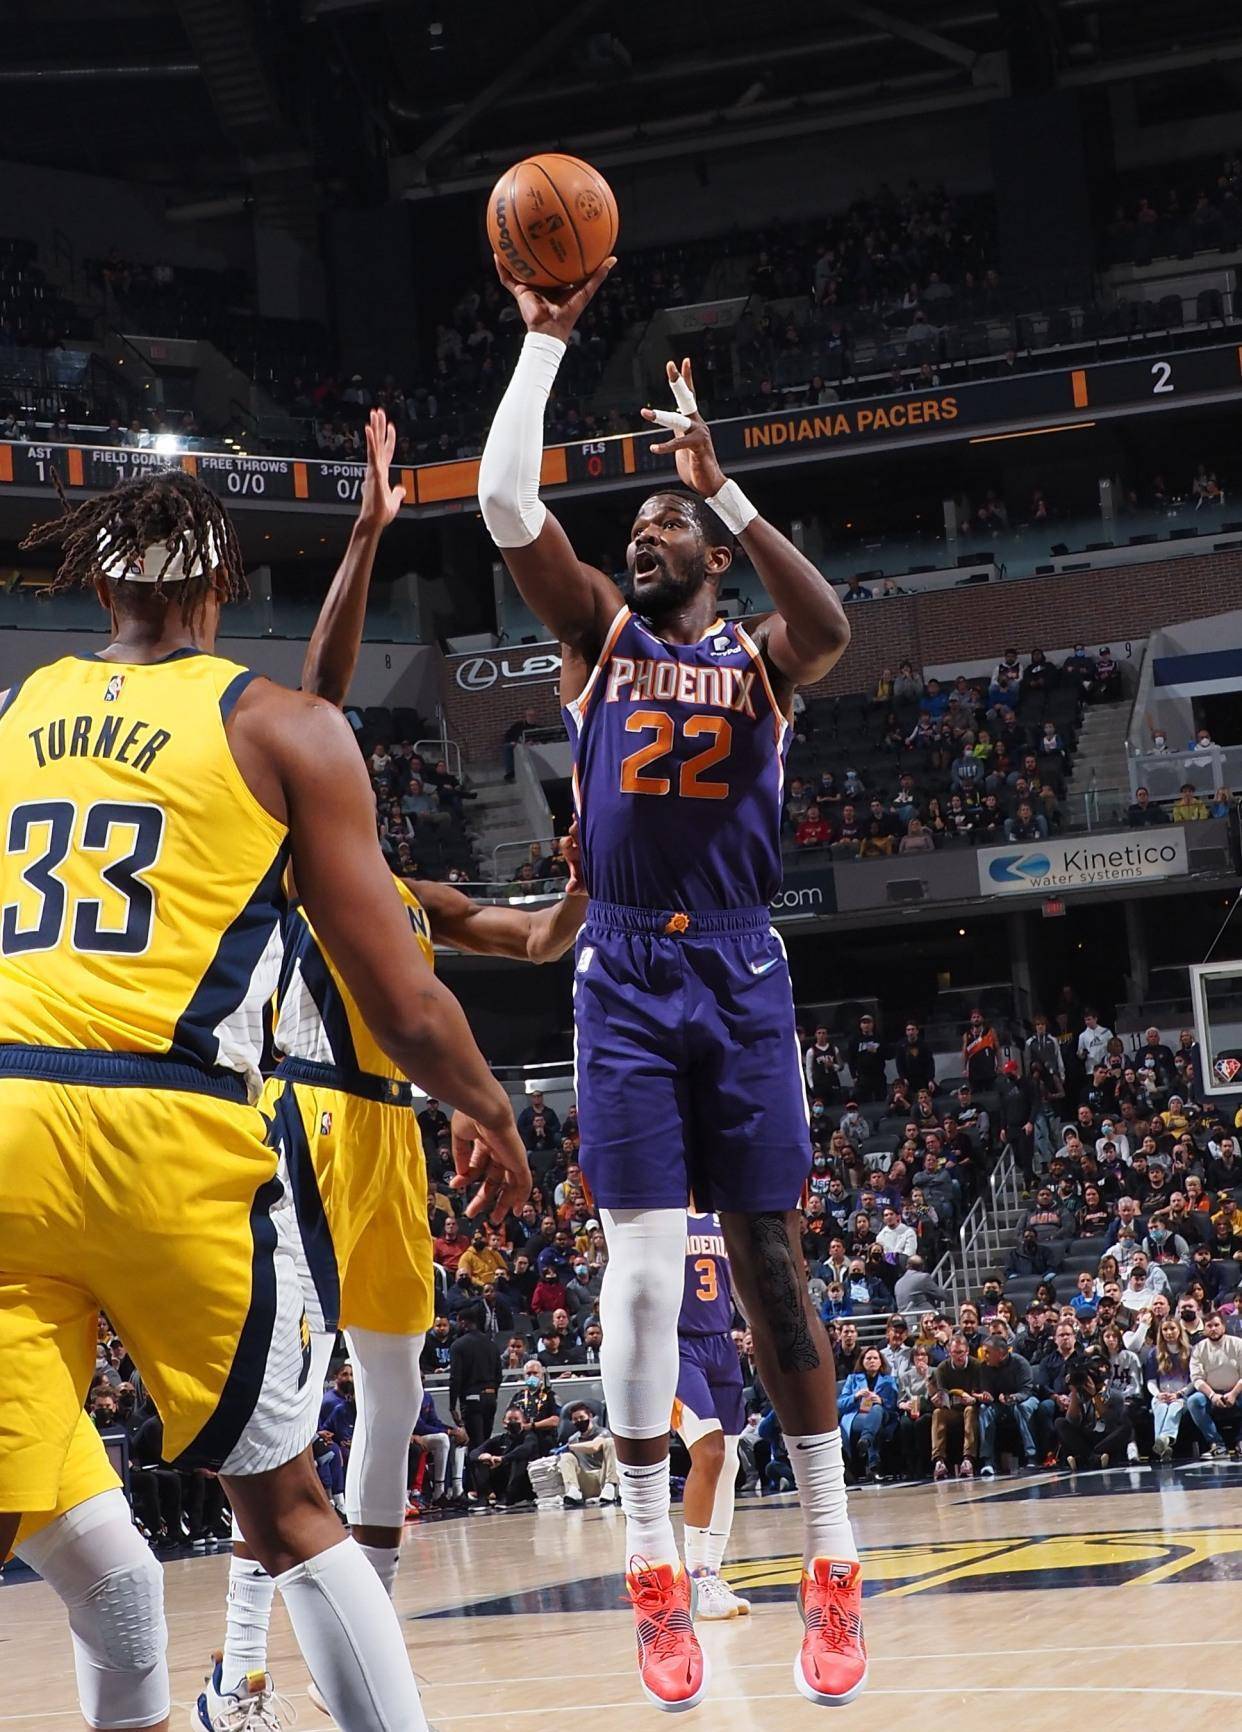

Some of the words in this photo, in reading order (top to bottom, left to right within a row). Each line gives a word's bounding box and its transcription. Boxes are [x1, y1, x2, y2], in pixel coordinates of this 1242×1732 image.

[1151, 361, 1174, 393] 2
[743, 414, 850, 449] INDIANA
[856, 397, 959, 432] PACERS
[27, 447, 52, 459] AST
[92, 450, 128, 463] FIELD
[131, 452, 172, 466] GOALS
[582, 442, 606, 456] FLS
[35, 461, 45, 482] 1
[202, 458, 233, 470] FREE
[235, 460, 288, 473] THROWS
[588, 456, 602, 476] 0
[227, 472, 265, 494] 0/0
[710, 644, 742, 656] PayPal
[1125, 642, 1132, 659] 9
[606, 657, 757, 719] PHOENIX
[28, 715, 171, 774] TURNER
[619, 709, 732, 799] 22
[1064, 844, 1176, 872] Kinetico
[1, 797, 166, 957] 33
[1030, 874, 1074, 887] water
[1080, 866, 1143, 884] systems
[694, 1258, 719, 1301] 3
